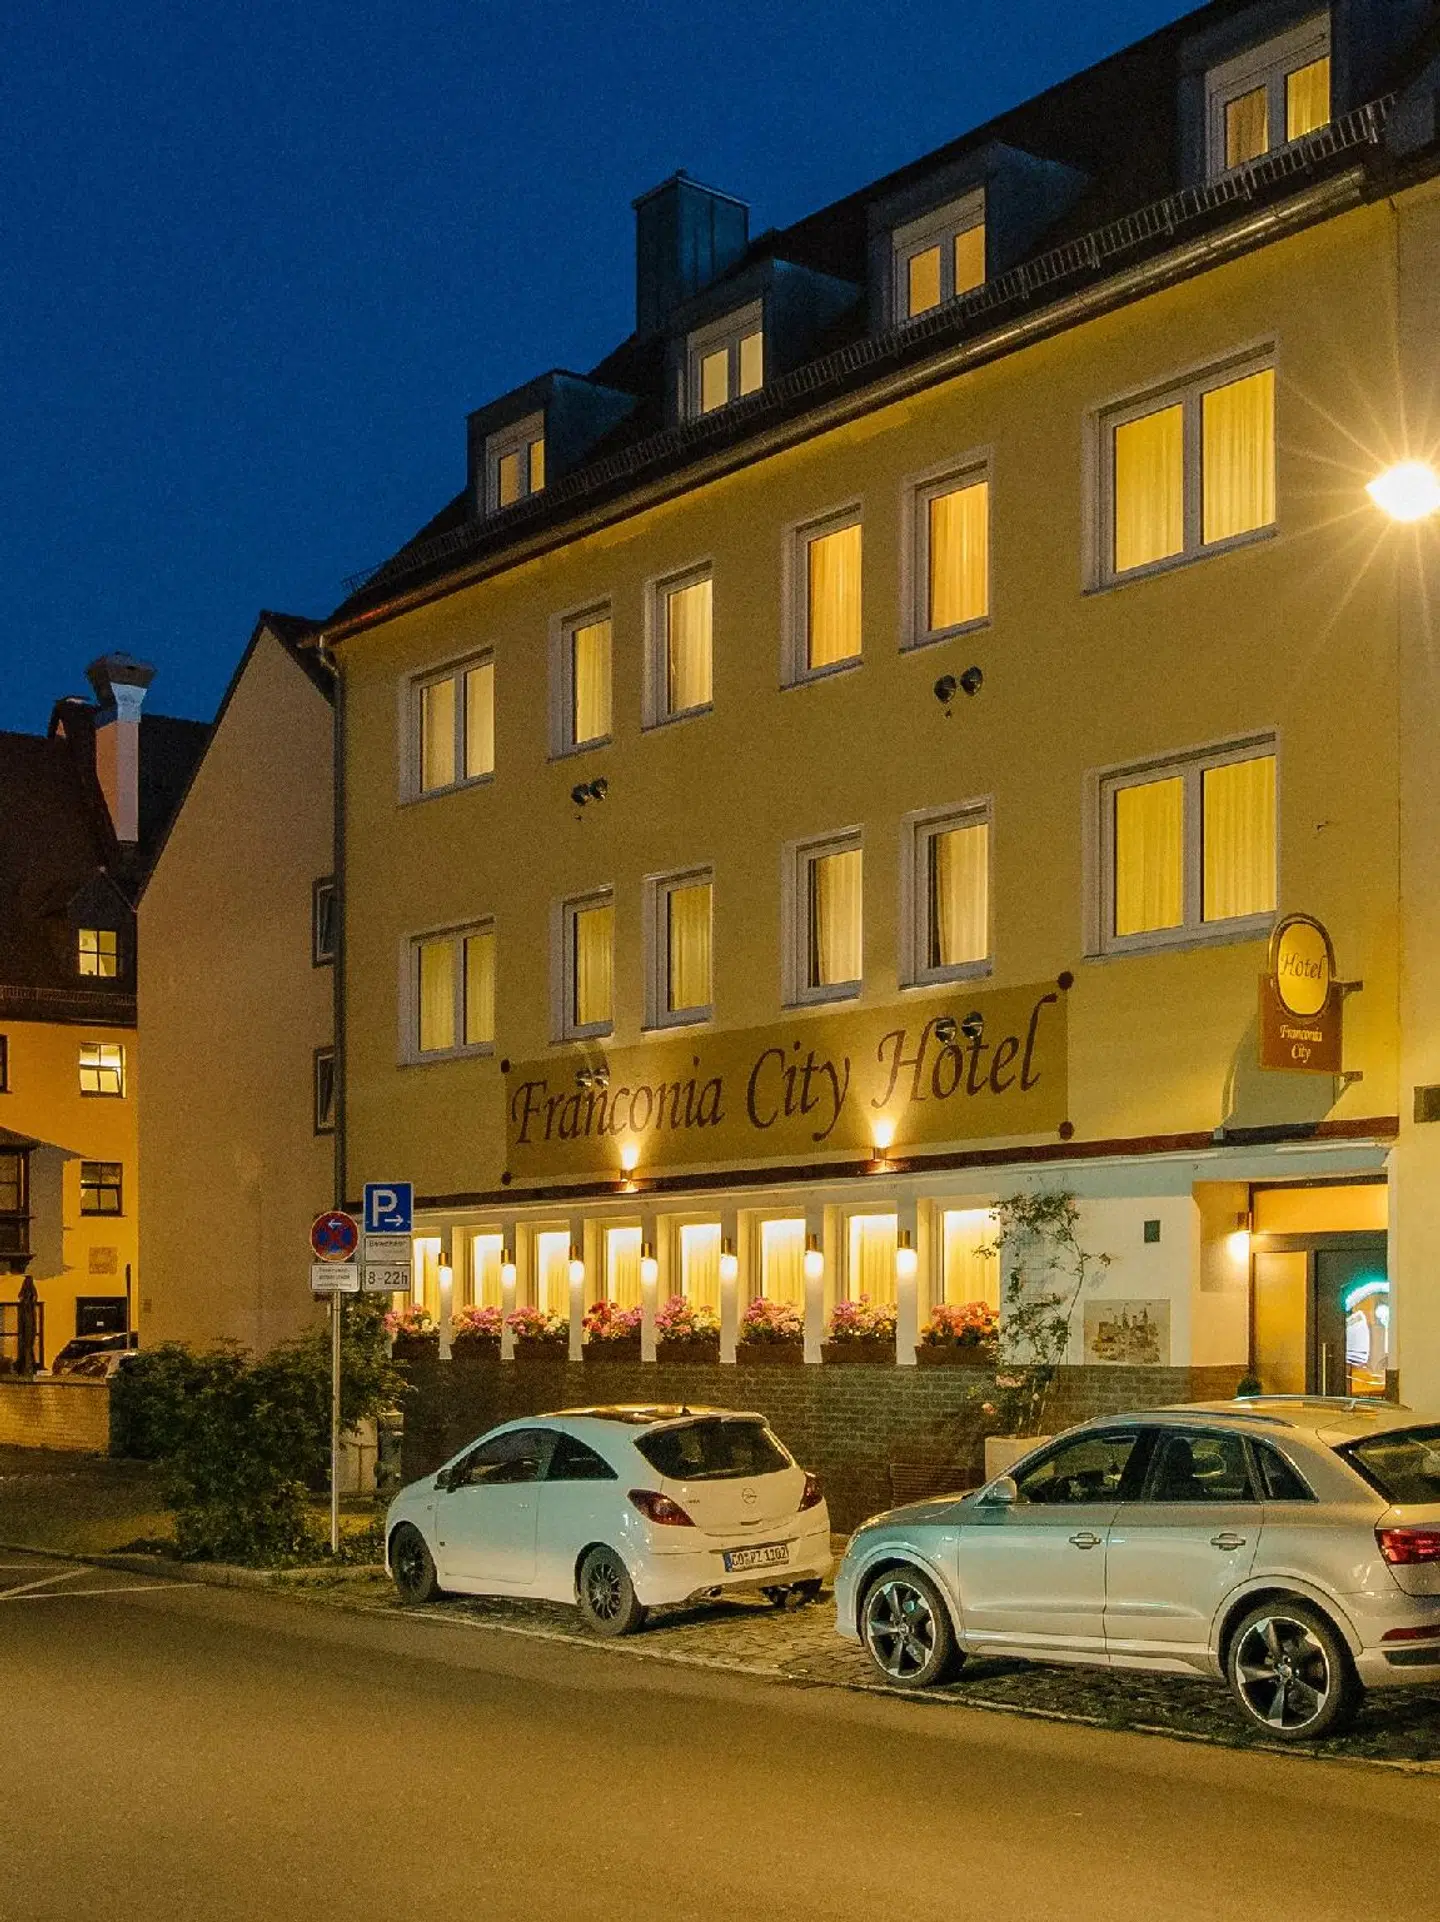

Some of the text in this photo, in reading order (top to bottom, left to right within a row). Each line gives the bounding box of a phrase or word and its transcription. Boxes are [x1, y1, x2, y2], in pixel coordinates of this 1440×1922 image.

[1280, 953, 1327, 980] Hotel
[511, 992, 1058, 1145] Franconia City Hotel
[1291, 1043, 1312, 1064] City
[372, 1189, 398, 1227] P
